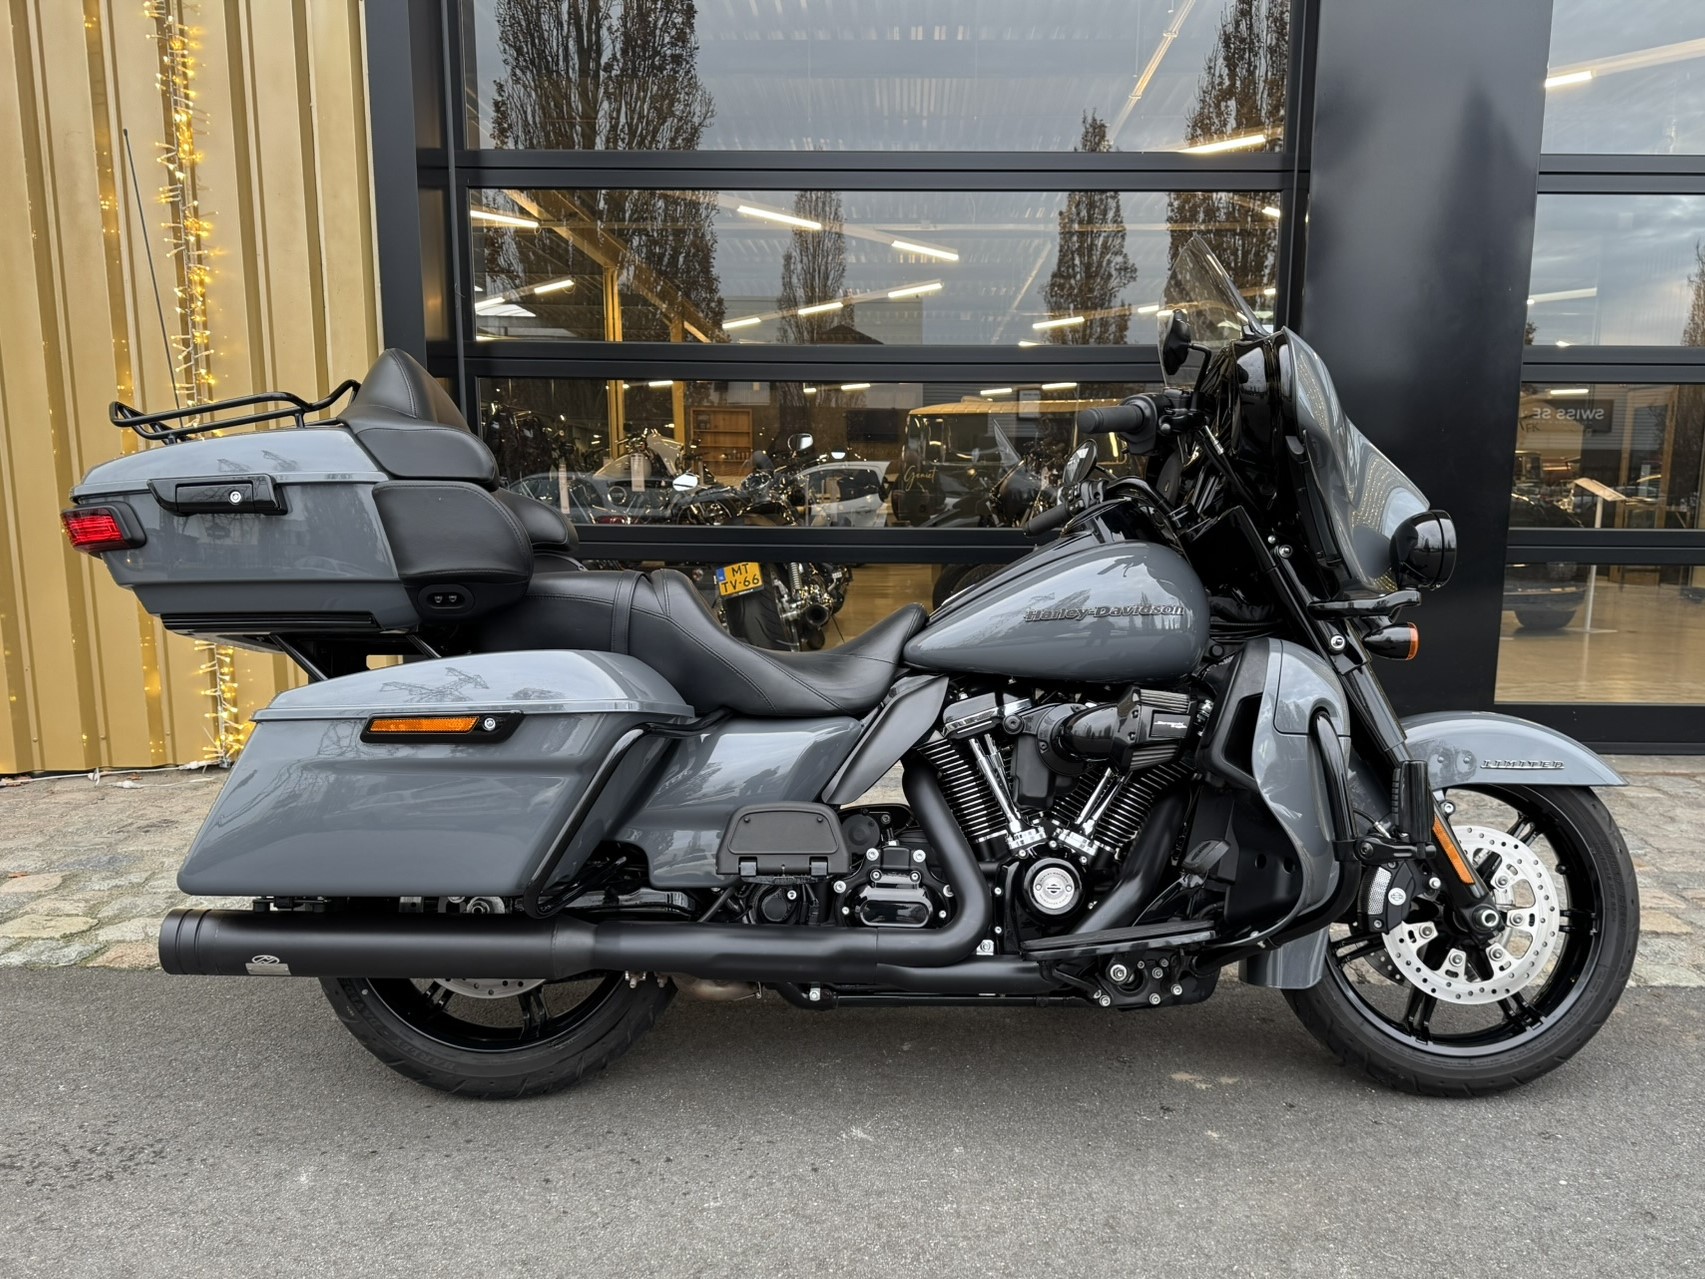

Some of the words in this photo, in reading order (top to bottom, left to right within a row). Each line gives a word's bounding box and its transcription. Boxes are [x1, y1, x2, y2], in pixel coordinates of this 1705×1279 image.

[731, 563, 749, 577] MT
[721, 573, 760, 592] TV-66
[1024, 604, 1184, 622] Harley-Davidson
[1480, 759, 1565, 770] LIMITED
